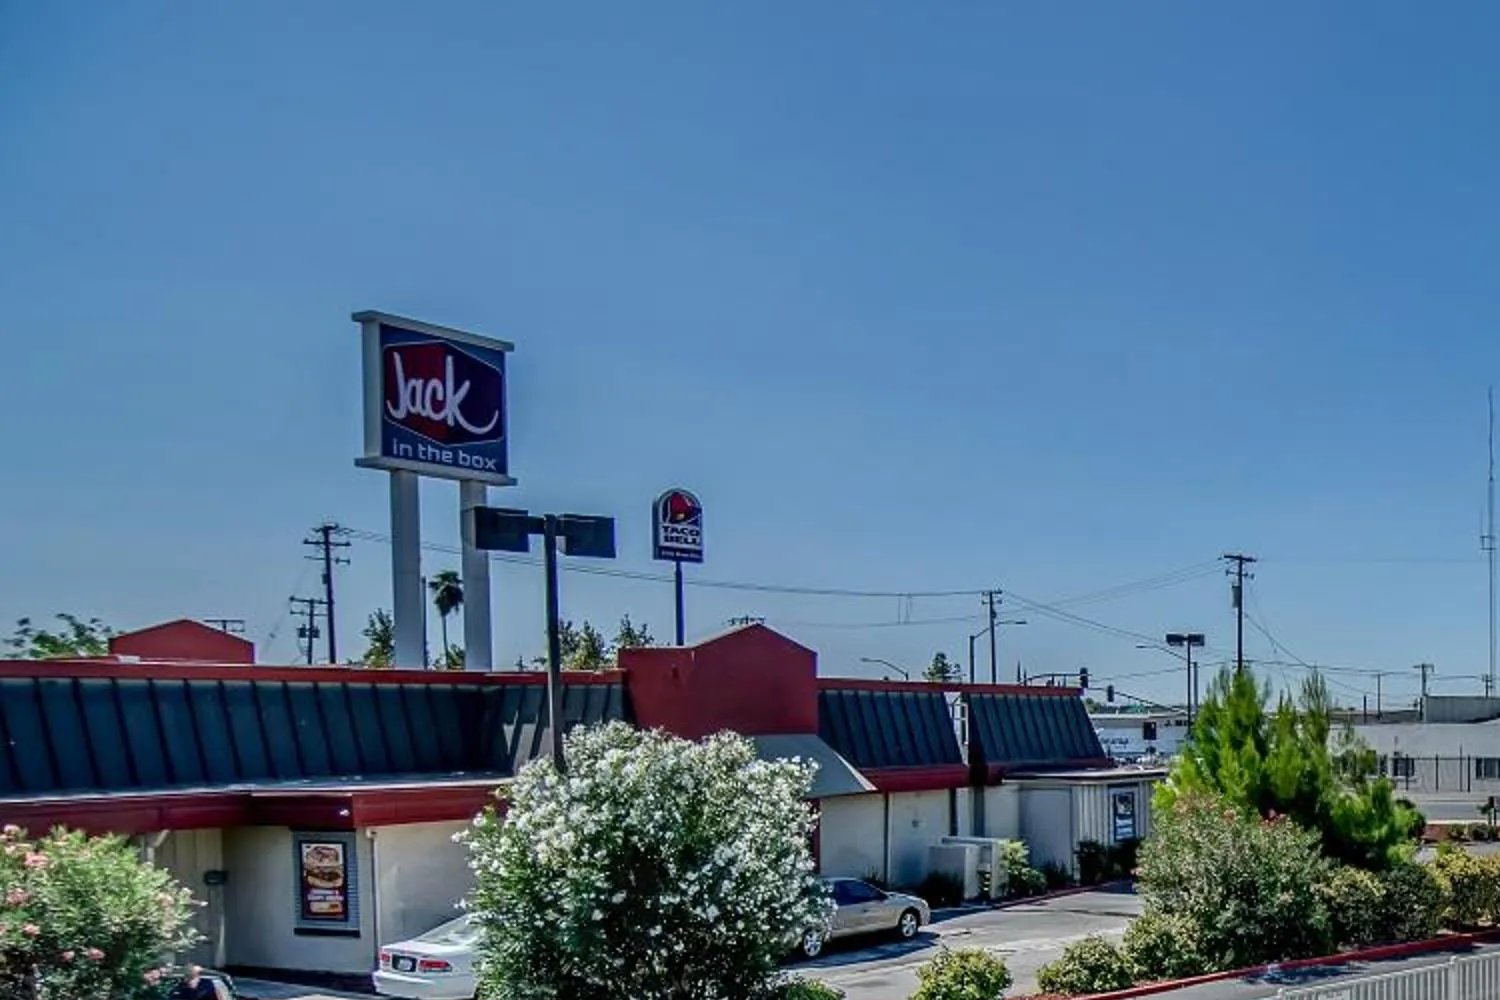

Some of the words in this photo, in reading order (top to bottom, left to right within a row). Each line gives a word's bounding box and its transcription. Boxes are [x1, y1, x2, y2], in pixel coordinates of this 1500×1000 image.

[387, 351, 499, 434] Jack
[393, 438, 413, 457] in
[418, 443, 453, 463] the
[458, 450, 497, 470] box
[662, 525, 700, 537] TACO
[663, 535, 699, 545] BELL
